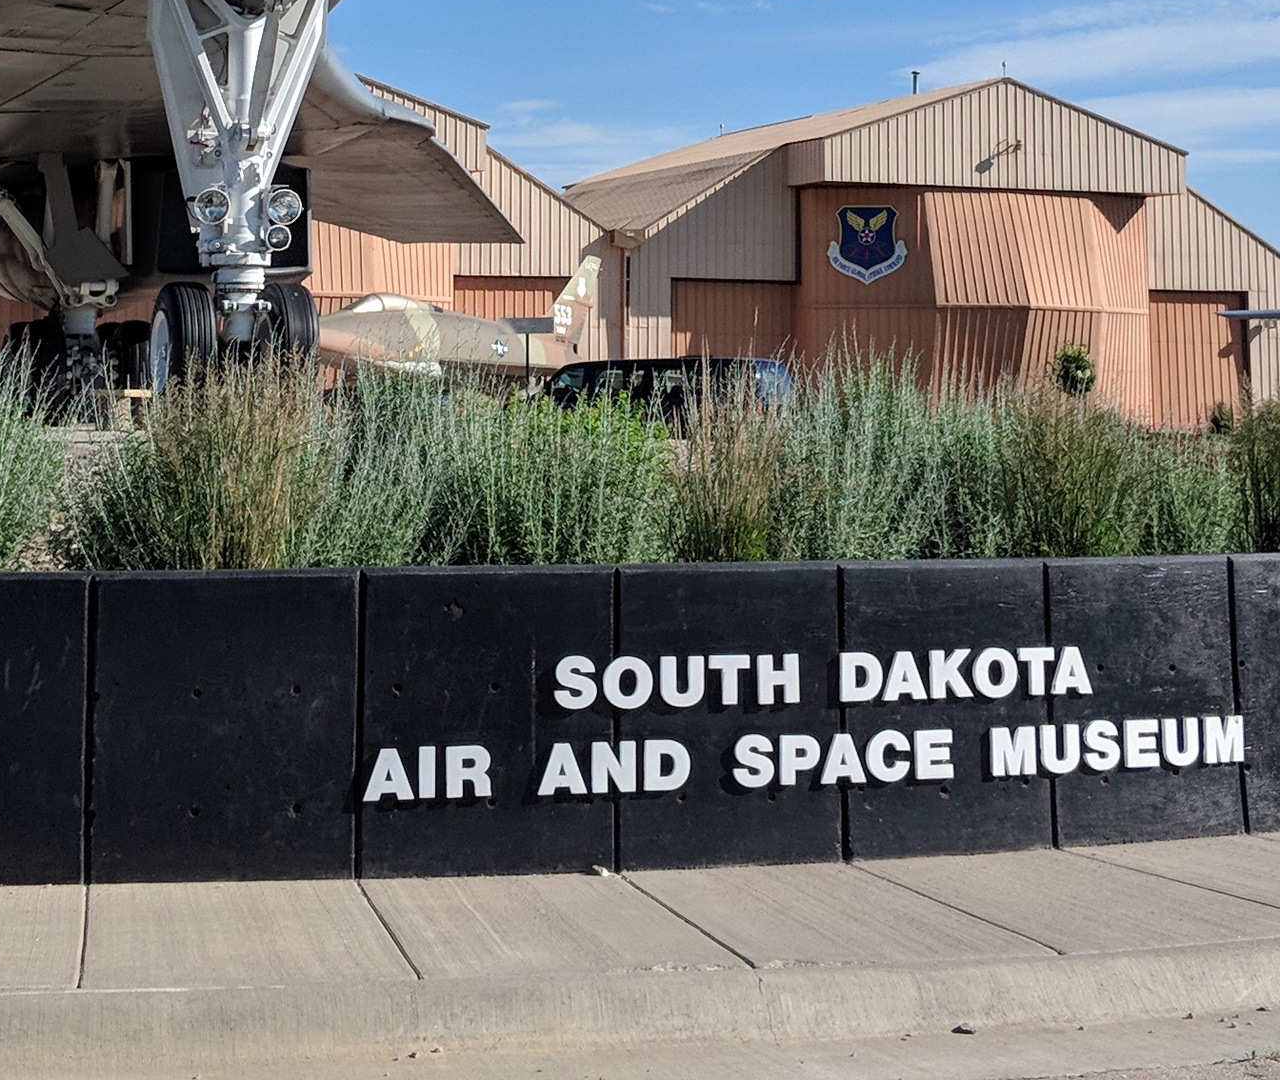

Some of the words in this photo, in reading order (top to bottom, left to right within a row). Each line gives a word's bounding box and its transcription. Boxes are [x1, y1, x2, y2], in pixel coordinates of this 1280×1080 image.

[554, 304, 572, 325] 553
[553, 653, 801, 710] SOUTH
[839, 646, 1095, 703] DAKOTA
[362, 744, 493, 803] AIR
[537, 738, 692, 797] AND
[732, 728, 955, 789] SPACE
[989, 715, 1245, 778] MUSEUM
